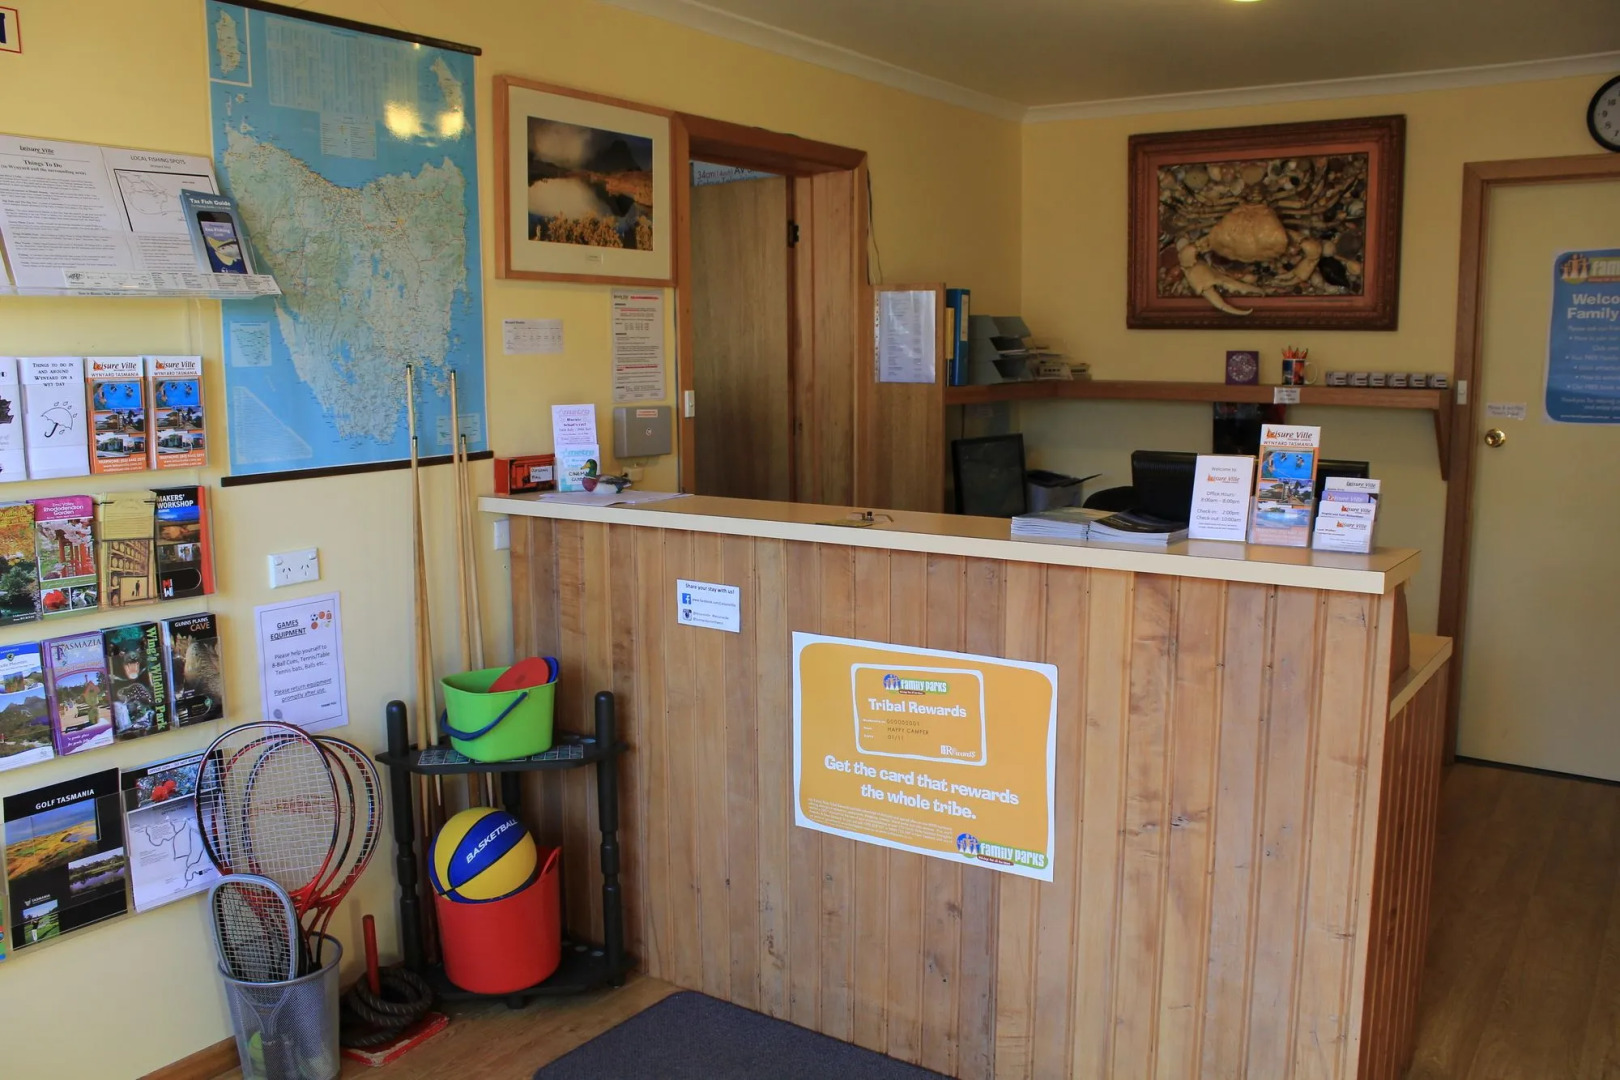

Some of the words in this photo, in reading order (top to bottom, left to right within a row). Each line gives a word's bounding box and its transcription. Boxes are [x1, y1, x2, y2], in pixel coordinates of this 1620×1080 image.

[1568, 308, 1619, 322] Family
[93, 360, 119, 371] Leisure
[155, 359, 180, 370] Leisure
[1266, 428, 1294, 440] Leisure
[157, 494, 185, 502] MAKERS'
[157, 500, 194, 509] WORKSHOP
[190, 622, 210, 632] CAVE
[277, 619, 299, 629] GAMES
[270, 628, 306, 640] EQUIPMENT
[51, 638, 102, 660] TASMAZIA
[146, 626, 160, 662] Wing's
[272, 660, 286, 668] 8-Ball
[286, 658, 299, 666] Cues,
[300, 651, 330, 661] Tennis/Table
[274, 651, 290, 660] Please
[291, 649, 301, 658] help
[302, 645, 321, 655] yourself
[152, 662, 164, 704] Wildlife
[307, 678, 332, 690] equipment
[901, 679, 924, 691] family
[925, 681, 947, 693] parks
[282, 692, 304, 703] promptly
[868, 698, 905, 712] Tribal
[909, 701, 967, 717] Rewards
[155, 705, 167, 730] Park
[824, 755, 851, 772] Get
[854, 761, 876, 777] the
[880, 768, 914, 785] card
[917, 774, 948, 792] that
[950, 782, 1019, 805] rewards
[35, 800, 54, 810] GOLF
[56, 788, 95, 804] TASMANIA
[861, 784, 884, 800] the
[887, 790, 930, 810] whole
[933, 799, 976, 819] tribe.
[466, 819, 518, 864] BASKETBALL
[981, 843, 1013, 860] family
[1015, 850, 1044, 867] parks
